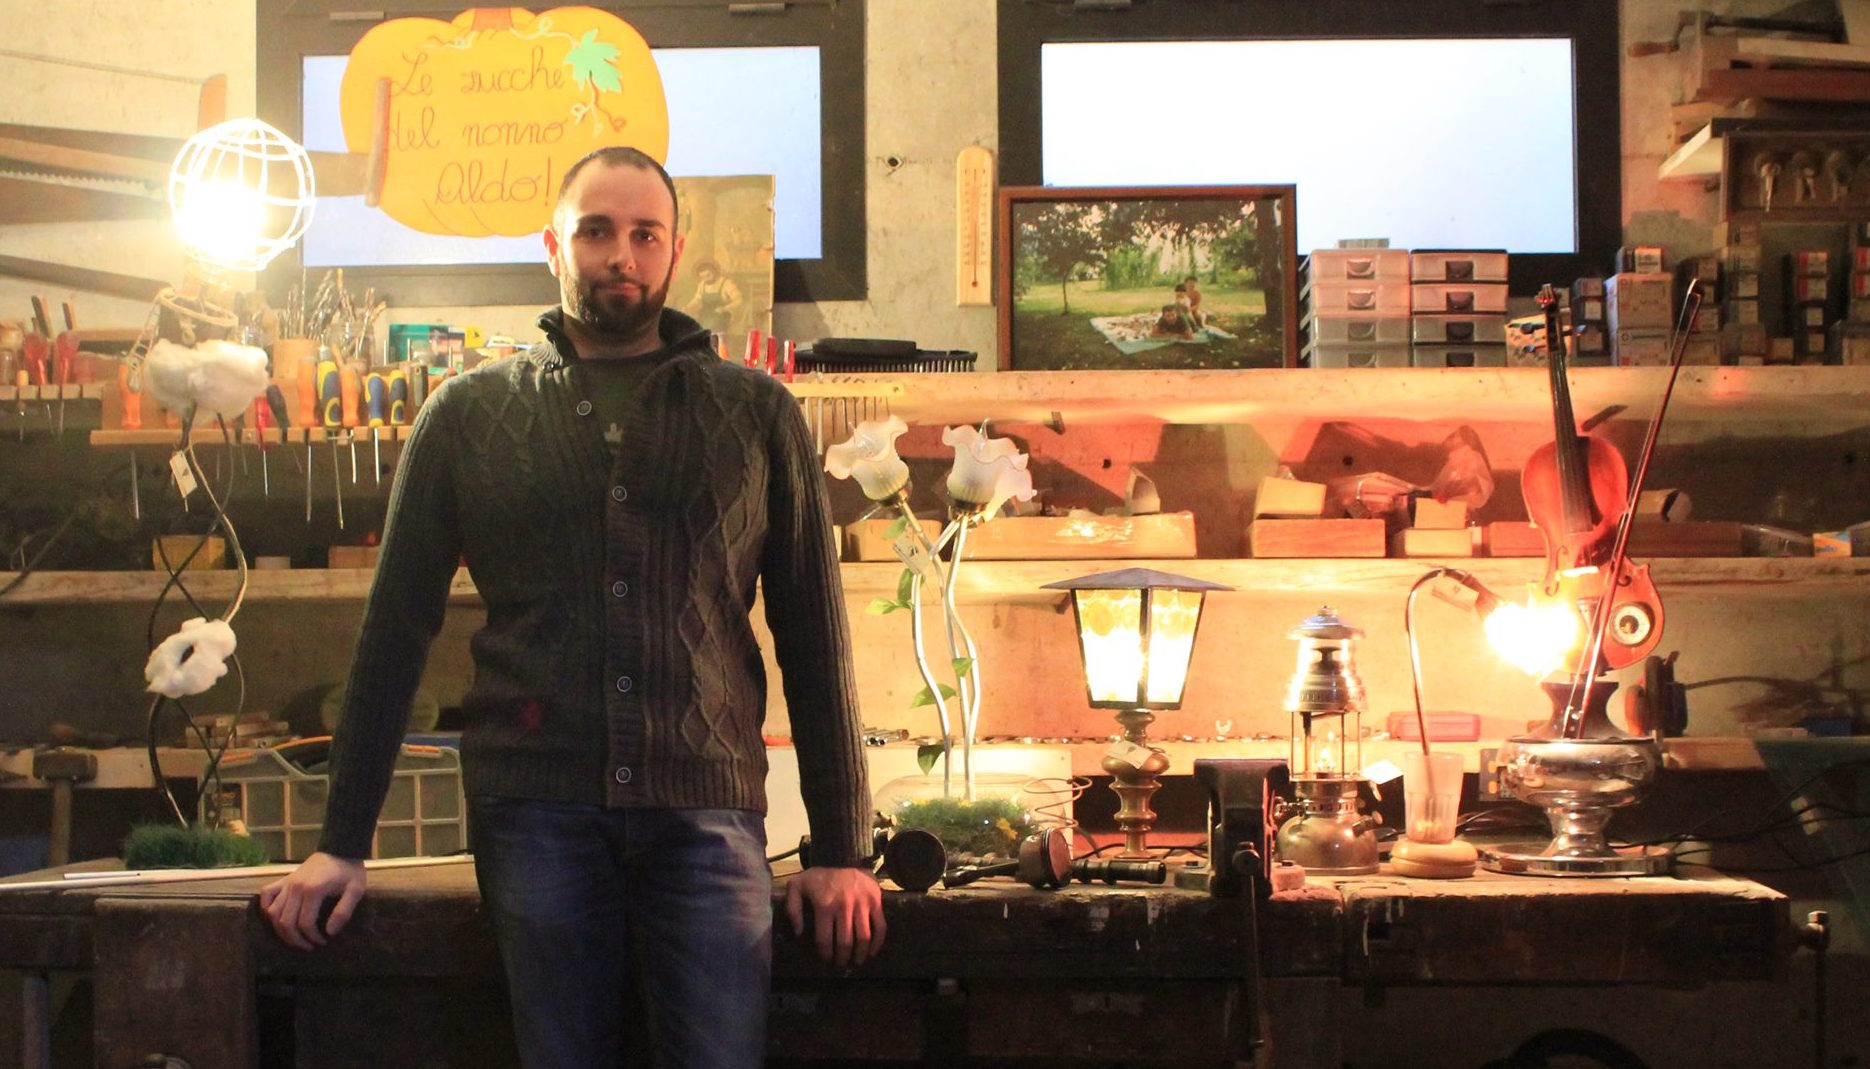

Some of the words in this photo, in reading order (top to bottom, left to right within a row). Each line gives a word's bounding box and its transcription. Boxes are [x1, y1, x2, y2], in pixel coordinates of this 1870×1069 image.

[390, 51, 434, 98] Le
[460, 46, 566, 94] zucche
[462, 118, 568, 148] nonno
[435, 155, 552, 207] Aldo!
